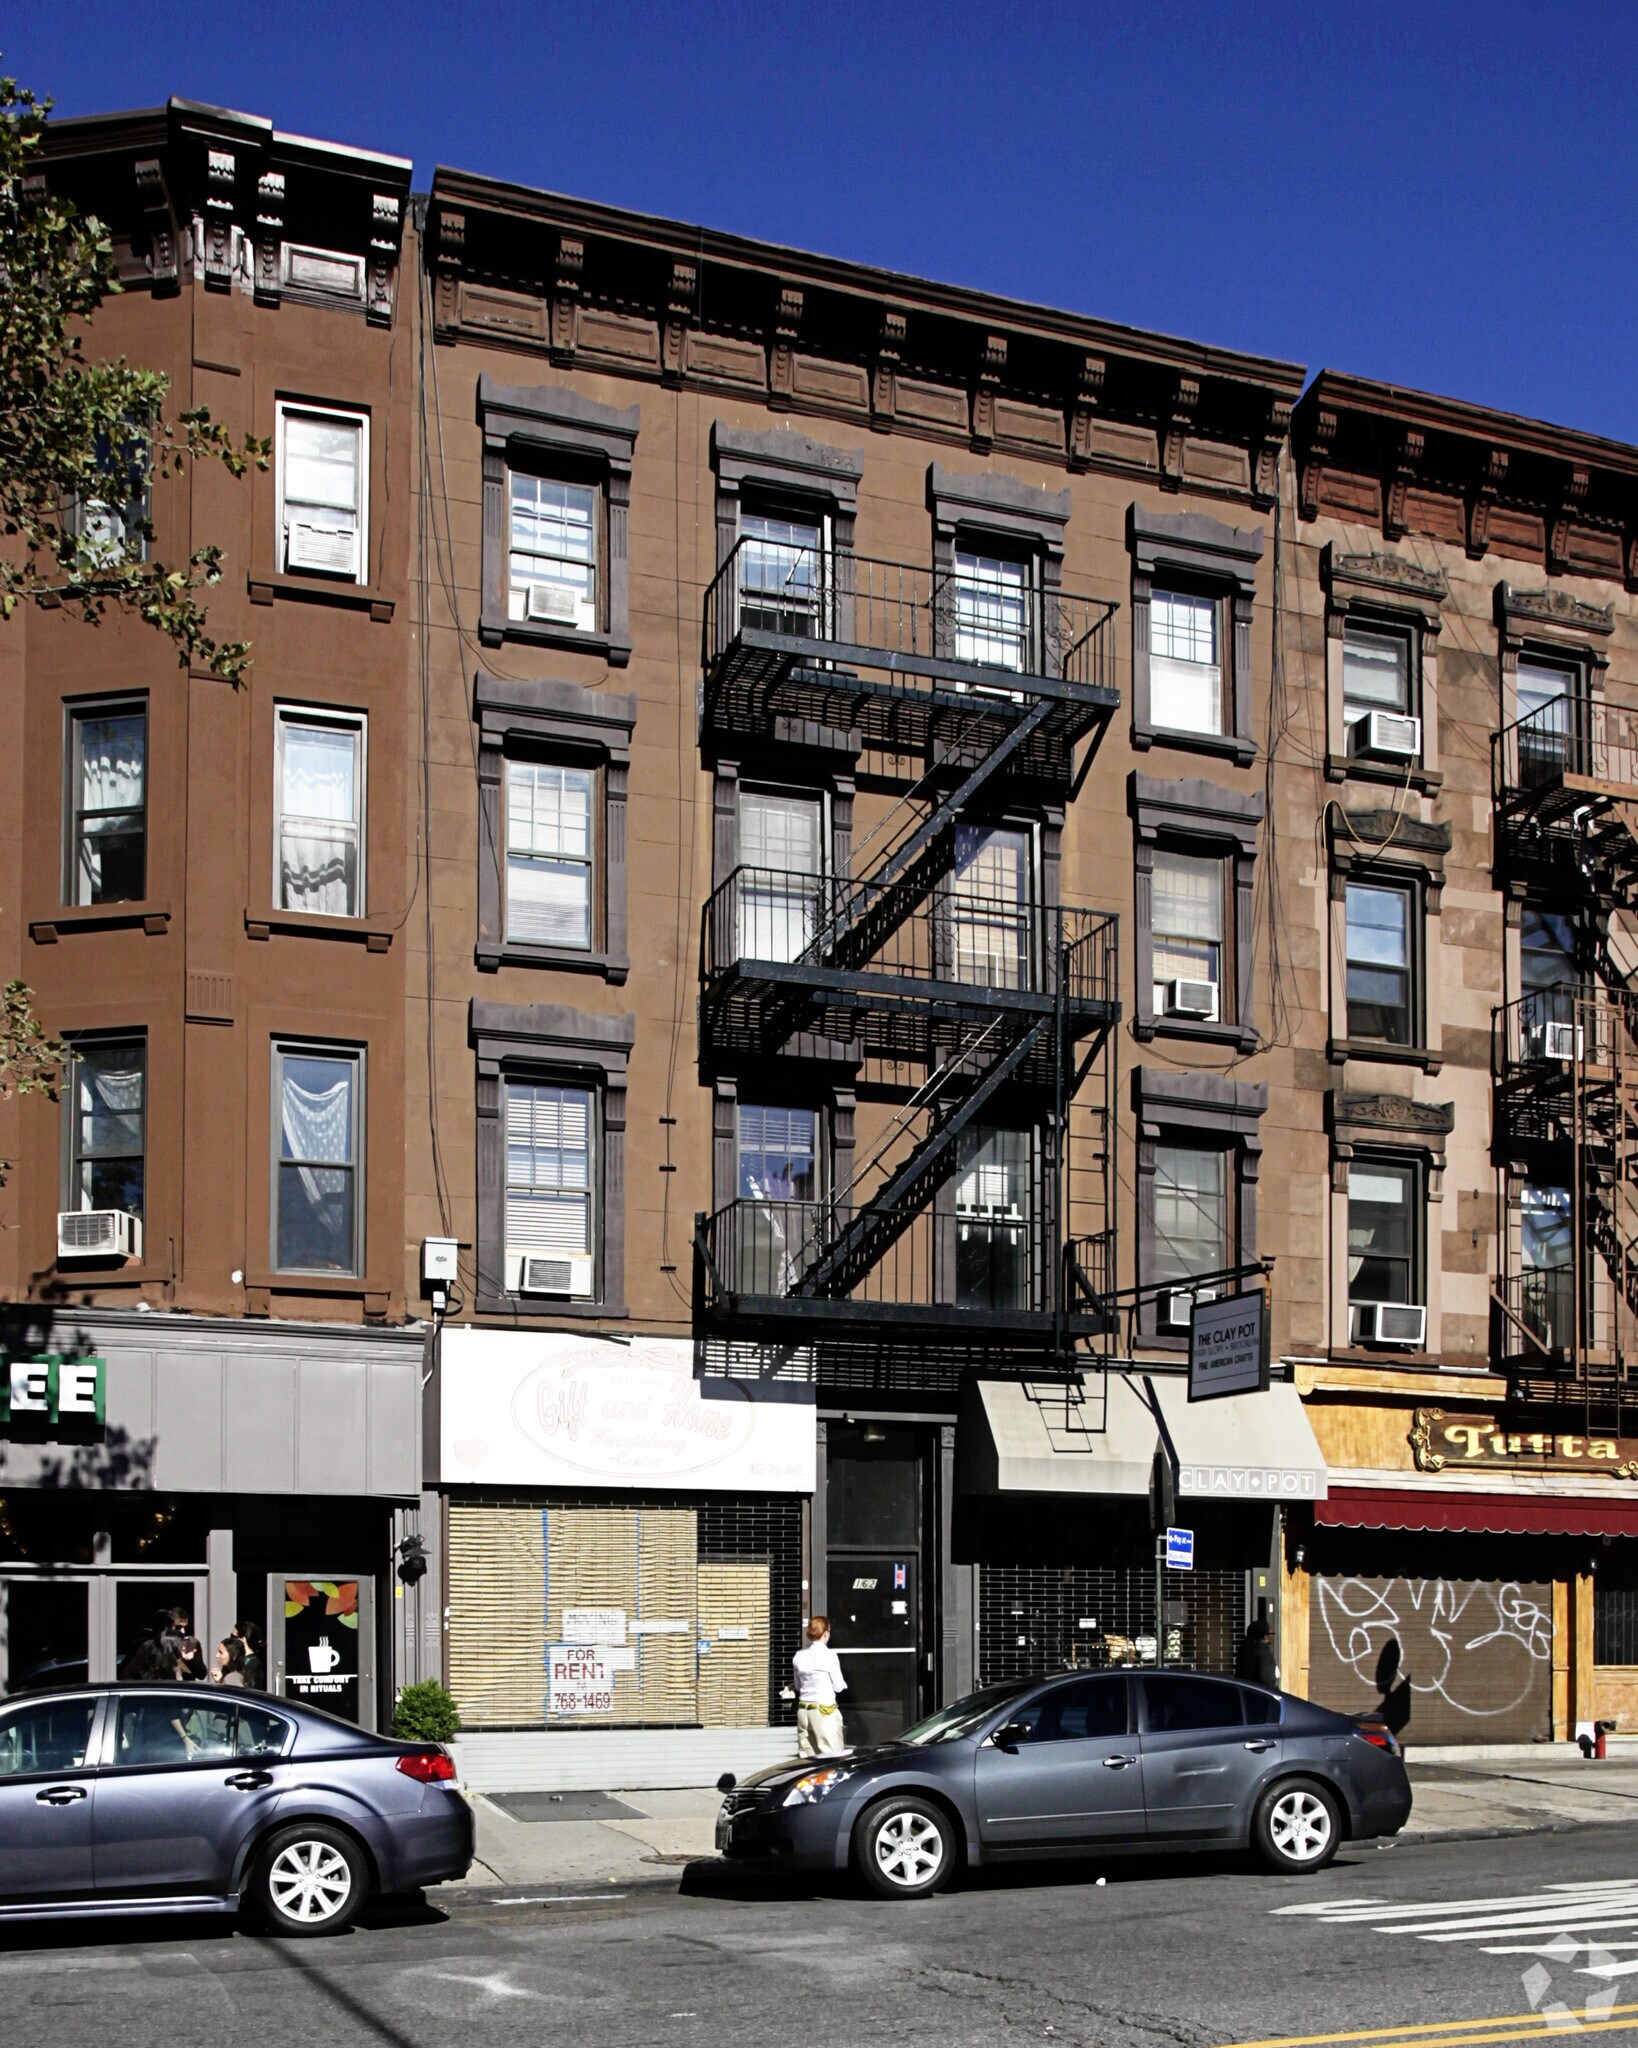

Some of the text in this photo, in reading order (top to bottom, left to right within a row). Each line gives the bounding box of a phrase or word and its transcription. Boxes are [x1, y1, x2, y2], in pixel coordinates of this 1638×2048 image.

[1198, 1322, 1255, 1346] THE CLAY POT
[1210, 1357, 1233, 1368] AMERICAN
[1234, 1352, 1254, 1364] CRAFTS
[536, 1376, 732, 1442] Gift and Home
[1444, 1424, 1620, 1459] Tutta
[1179, 1471, 1313, 1492] CLAY POT
[855, 1579, 876, 1589] 162
[567, 1649, 595, 1661] FOR
[554, 1662, 605, 1680] RENT
[299, 1684, 342, 1693] IN RITUALS
[554, 1692, 611, 1710] 768-1469
